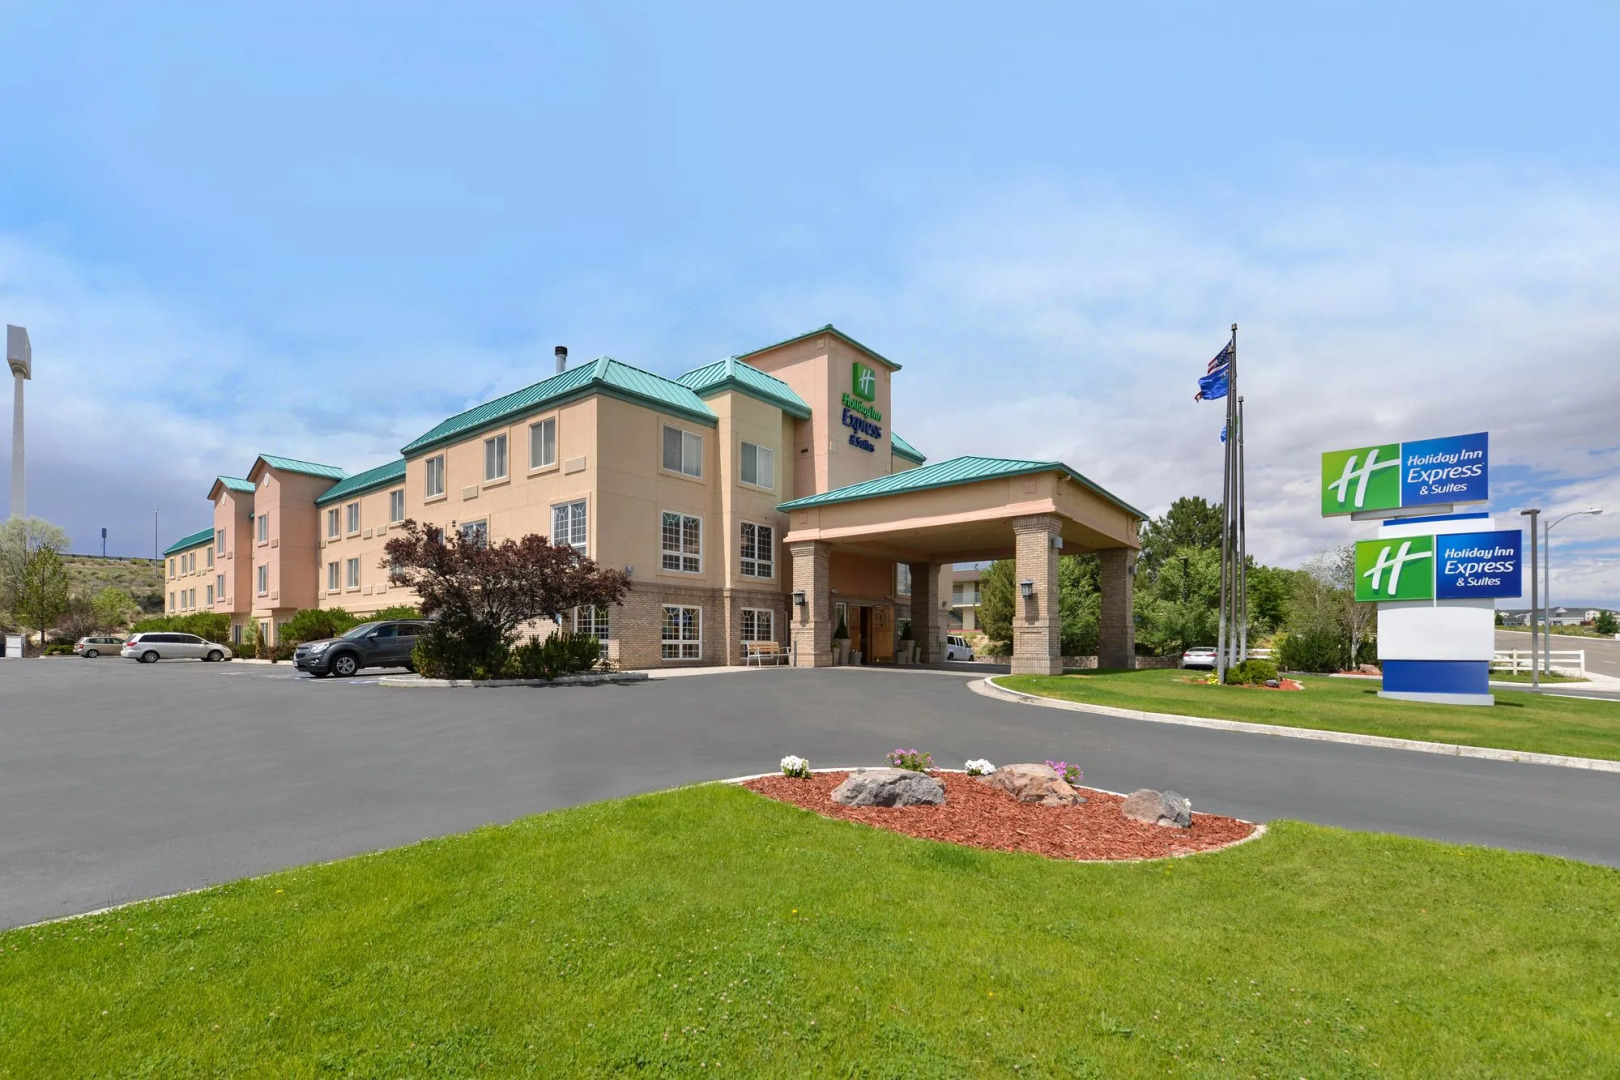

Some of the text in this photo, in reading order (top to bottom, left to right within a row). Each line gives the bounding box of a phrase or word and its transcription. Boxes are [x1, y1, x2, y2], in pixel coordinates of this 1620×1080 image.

[870, 406, 882, 421] Inn
[842, 407, 882, 439] Express
[1407, 449, 1483, 466] Holiday Inn
[1407, 464, 1483, 484] Express
[1420, 483, 1468, 495] & Suites
[1444, 546, 1514, 559] Holiday Inn
[1444, 560, 1515, 577] Express
[1456, 576, 1501, 587] & Suites
